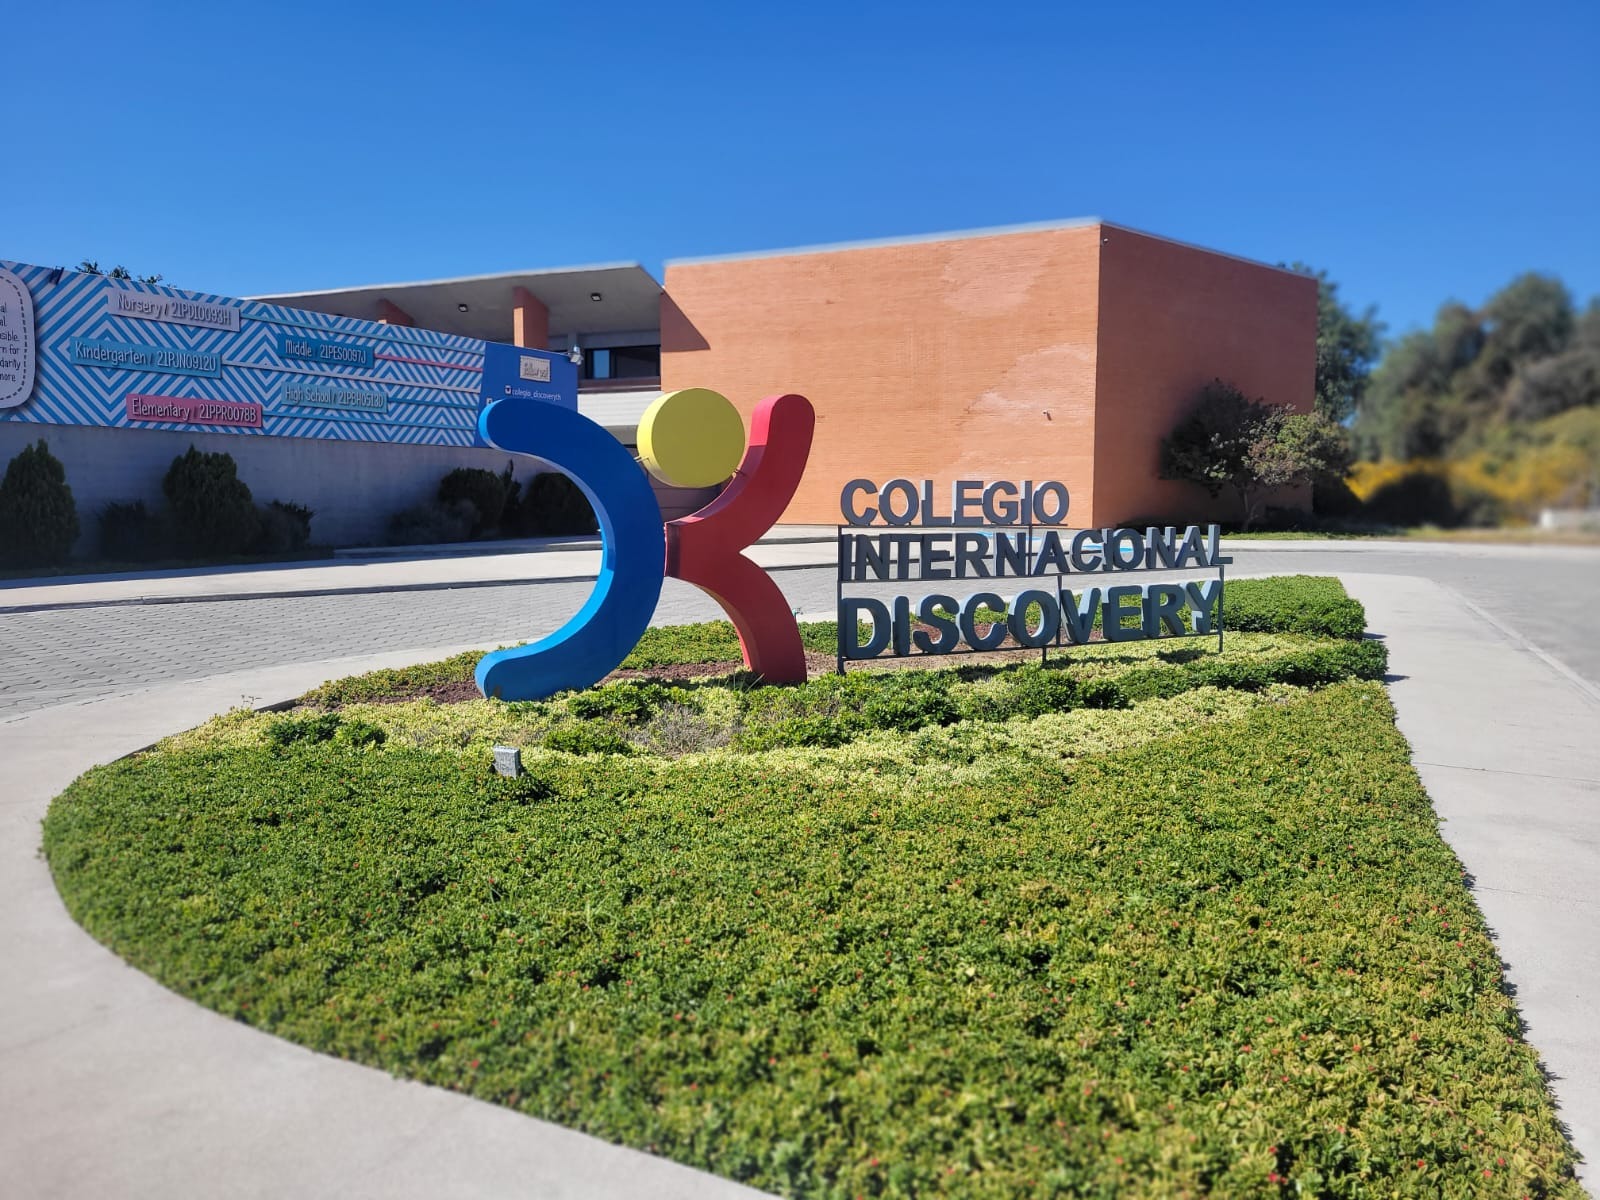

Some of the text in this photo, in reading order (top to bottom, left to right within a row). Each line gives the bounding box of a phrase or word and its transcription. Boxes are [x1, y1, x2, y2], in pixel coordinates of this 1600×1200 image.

[118, 294, 162, 319] Nursery
[75, 341, 146, 365] Kindergarten
[285, 339, 312, 357] Middle
[286, 384, 304, 403] High
[306, 387, 331, 403] School
[132, 398, 190, 421] Elementary
[841, 479, 1070, 526] COLEGIO
[841, 524, 1233, 580] INTERNACIONAL
[840, 579, 1223, 659] DISCOVERY
